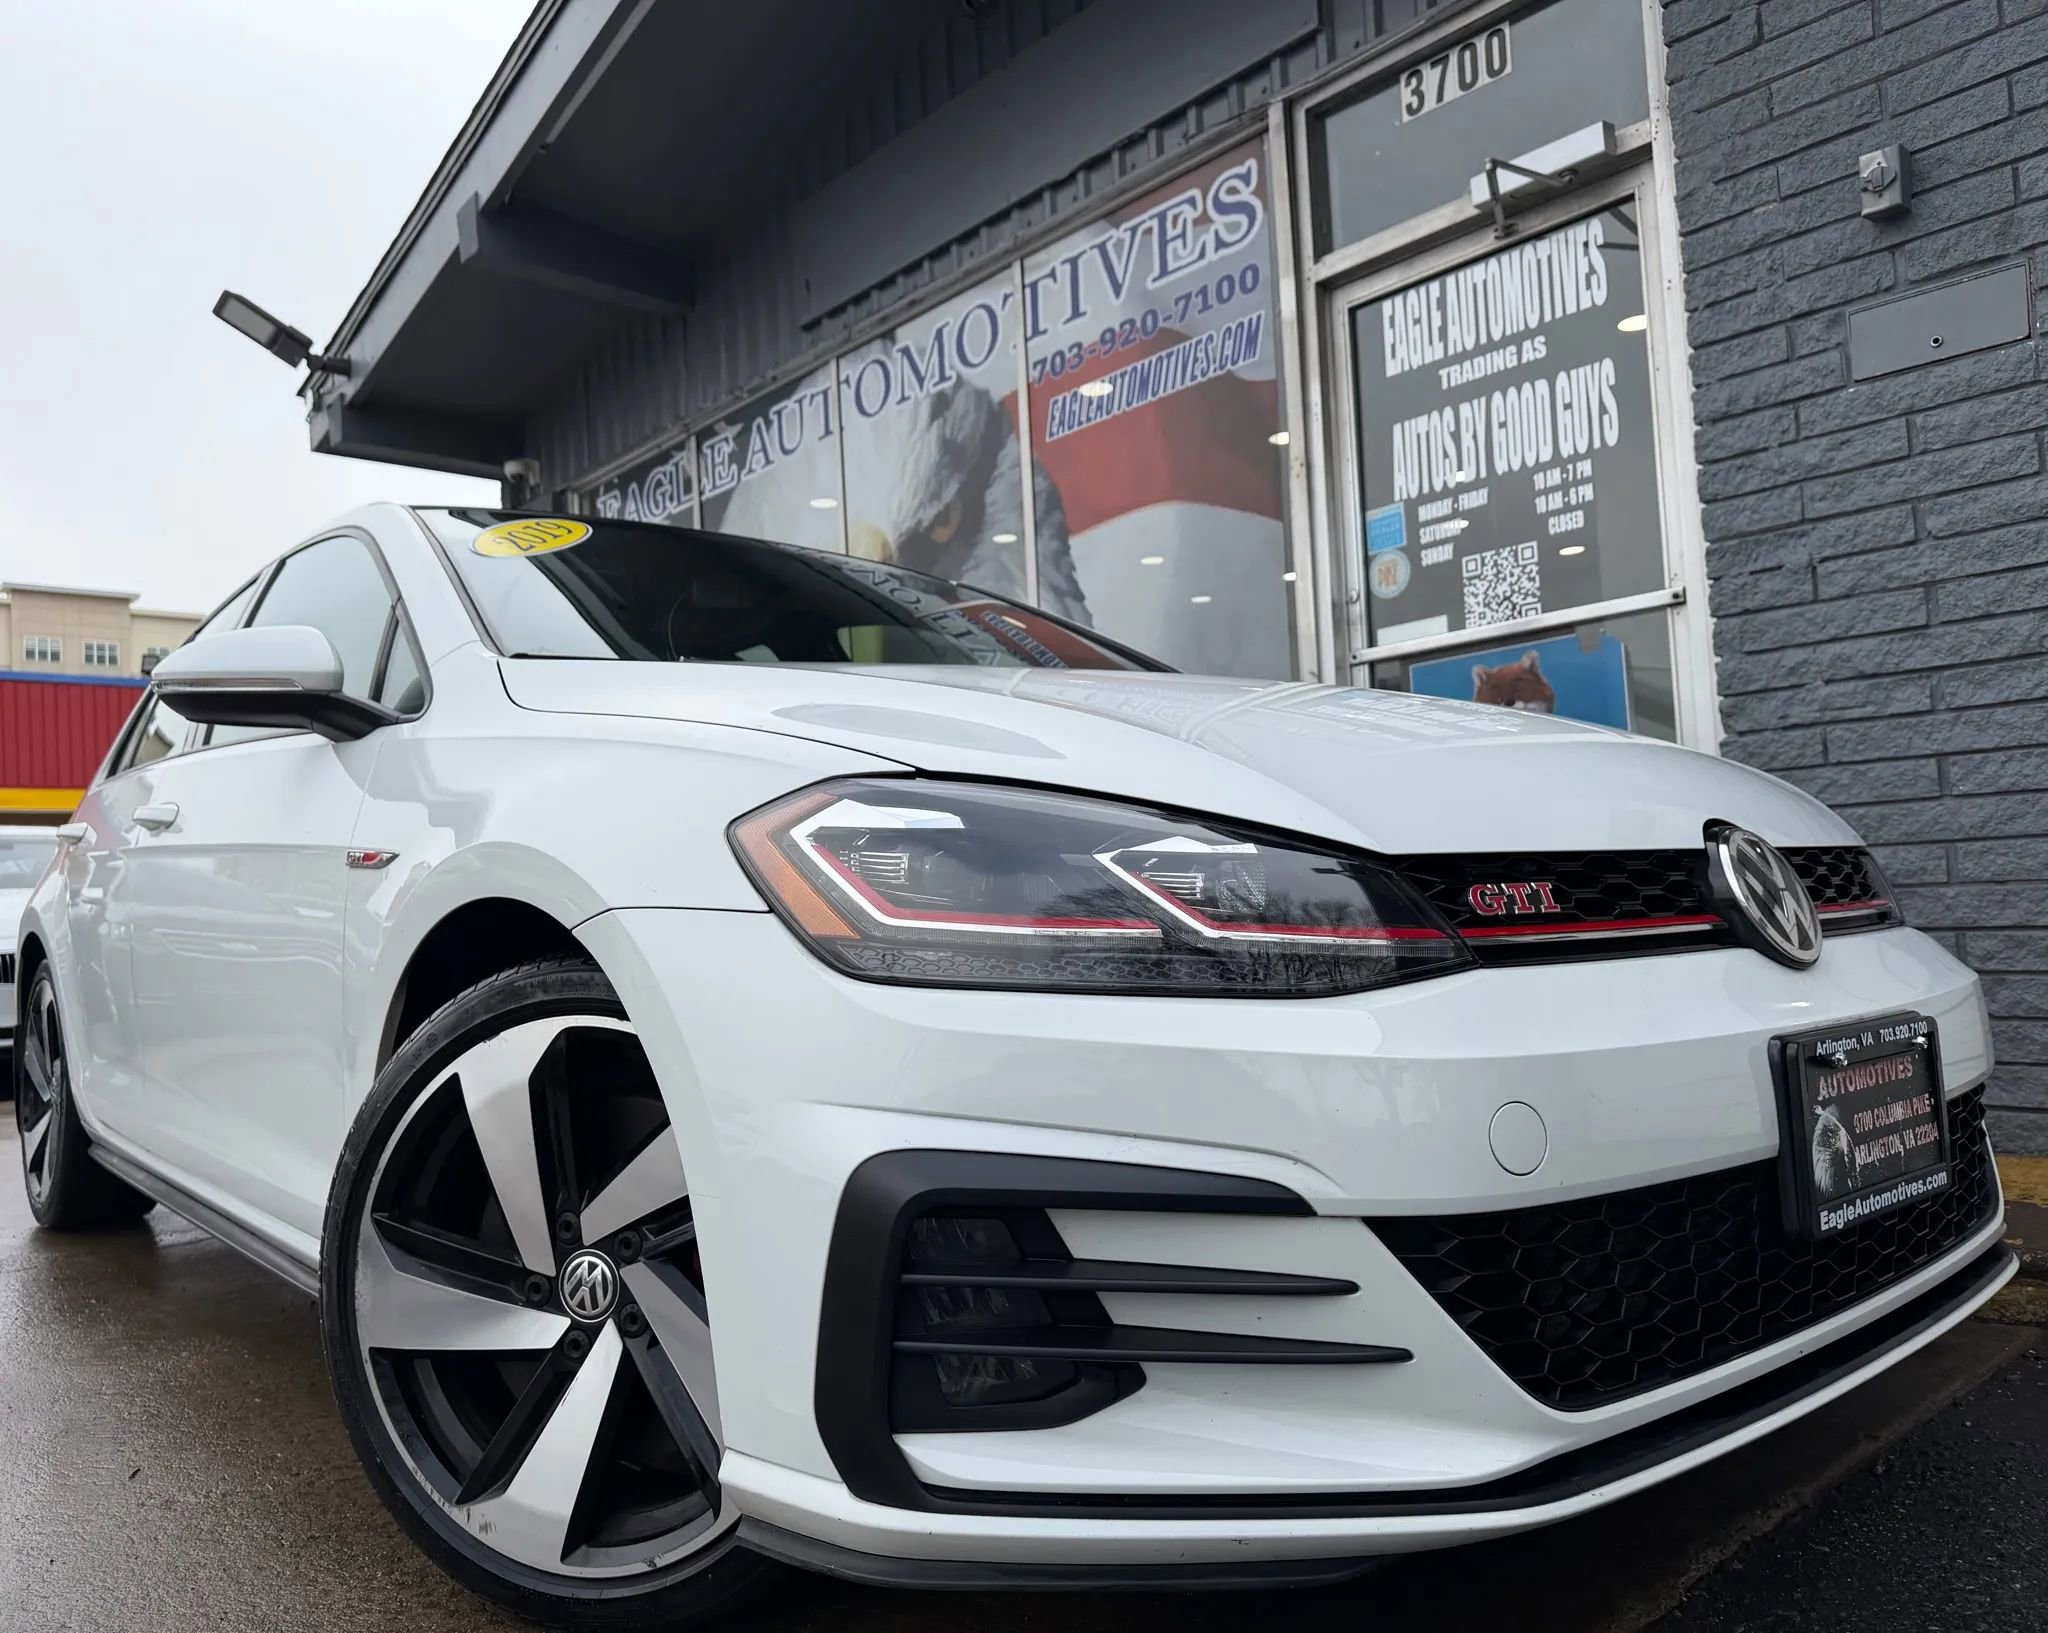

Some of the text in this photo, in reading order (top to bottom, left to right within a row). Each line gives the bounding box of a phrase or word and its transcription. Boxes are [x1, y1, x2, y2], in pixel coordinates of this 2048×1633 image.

[1403, 28, 1509, 117] 3700
[1381, 217, 1608, 378] EAGLE AUTOMOTIVES
[1032, 262, 1262, 384] 703-920-7100
[1438, 334, 1548, 390] TRADING AS
[1391, 357, 1620, 502] AUTOS BY GOOD GUYS
[1545, 467, 1563, 488] AM
[1576, 458, 1592, 479] PM
[1547, 490, 1564, 511] AM
[1578, 482, 1594, 503] PM
[492, 520, 573, 551] 2019
[1548, 509, 1585, 536] CLOSED
[1468, 882, 1561, 917] GTI
[1816, 1021, 1928, 1056] Arlington, VA 703.920.7100
[1817, 1055, 1913, 1101] AUTOMOTIVES
[1853, 1092, 1931, 1134] 3700 COLUMBIA PIKE
[1903, 1128, 1915, 1149] VA
[1819, 1170, 1948, 1231] EagleAutomotives.com
